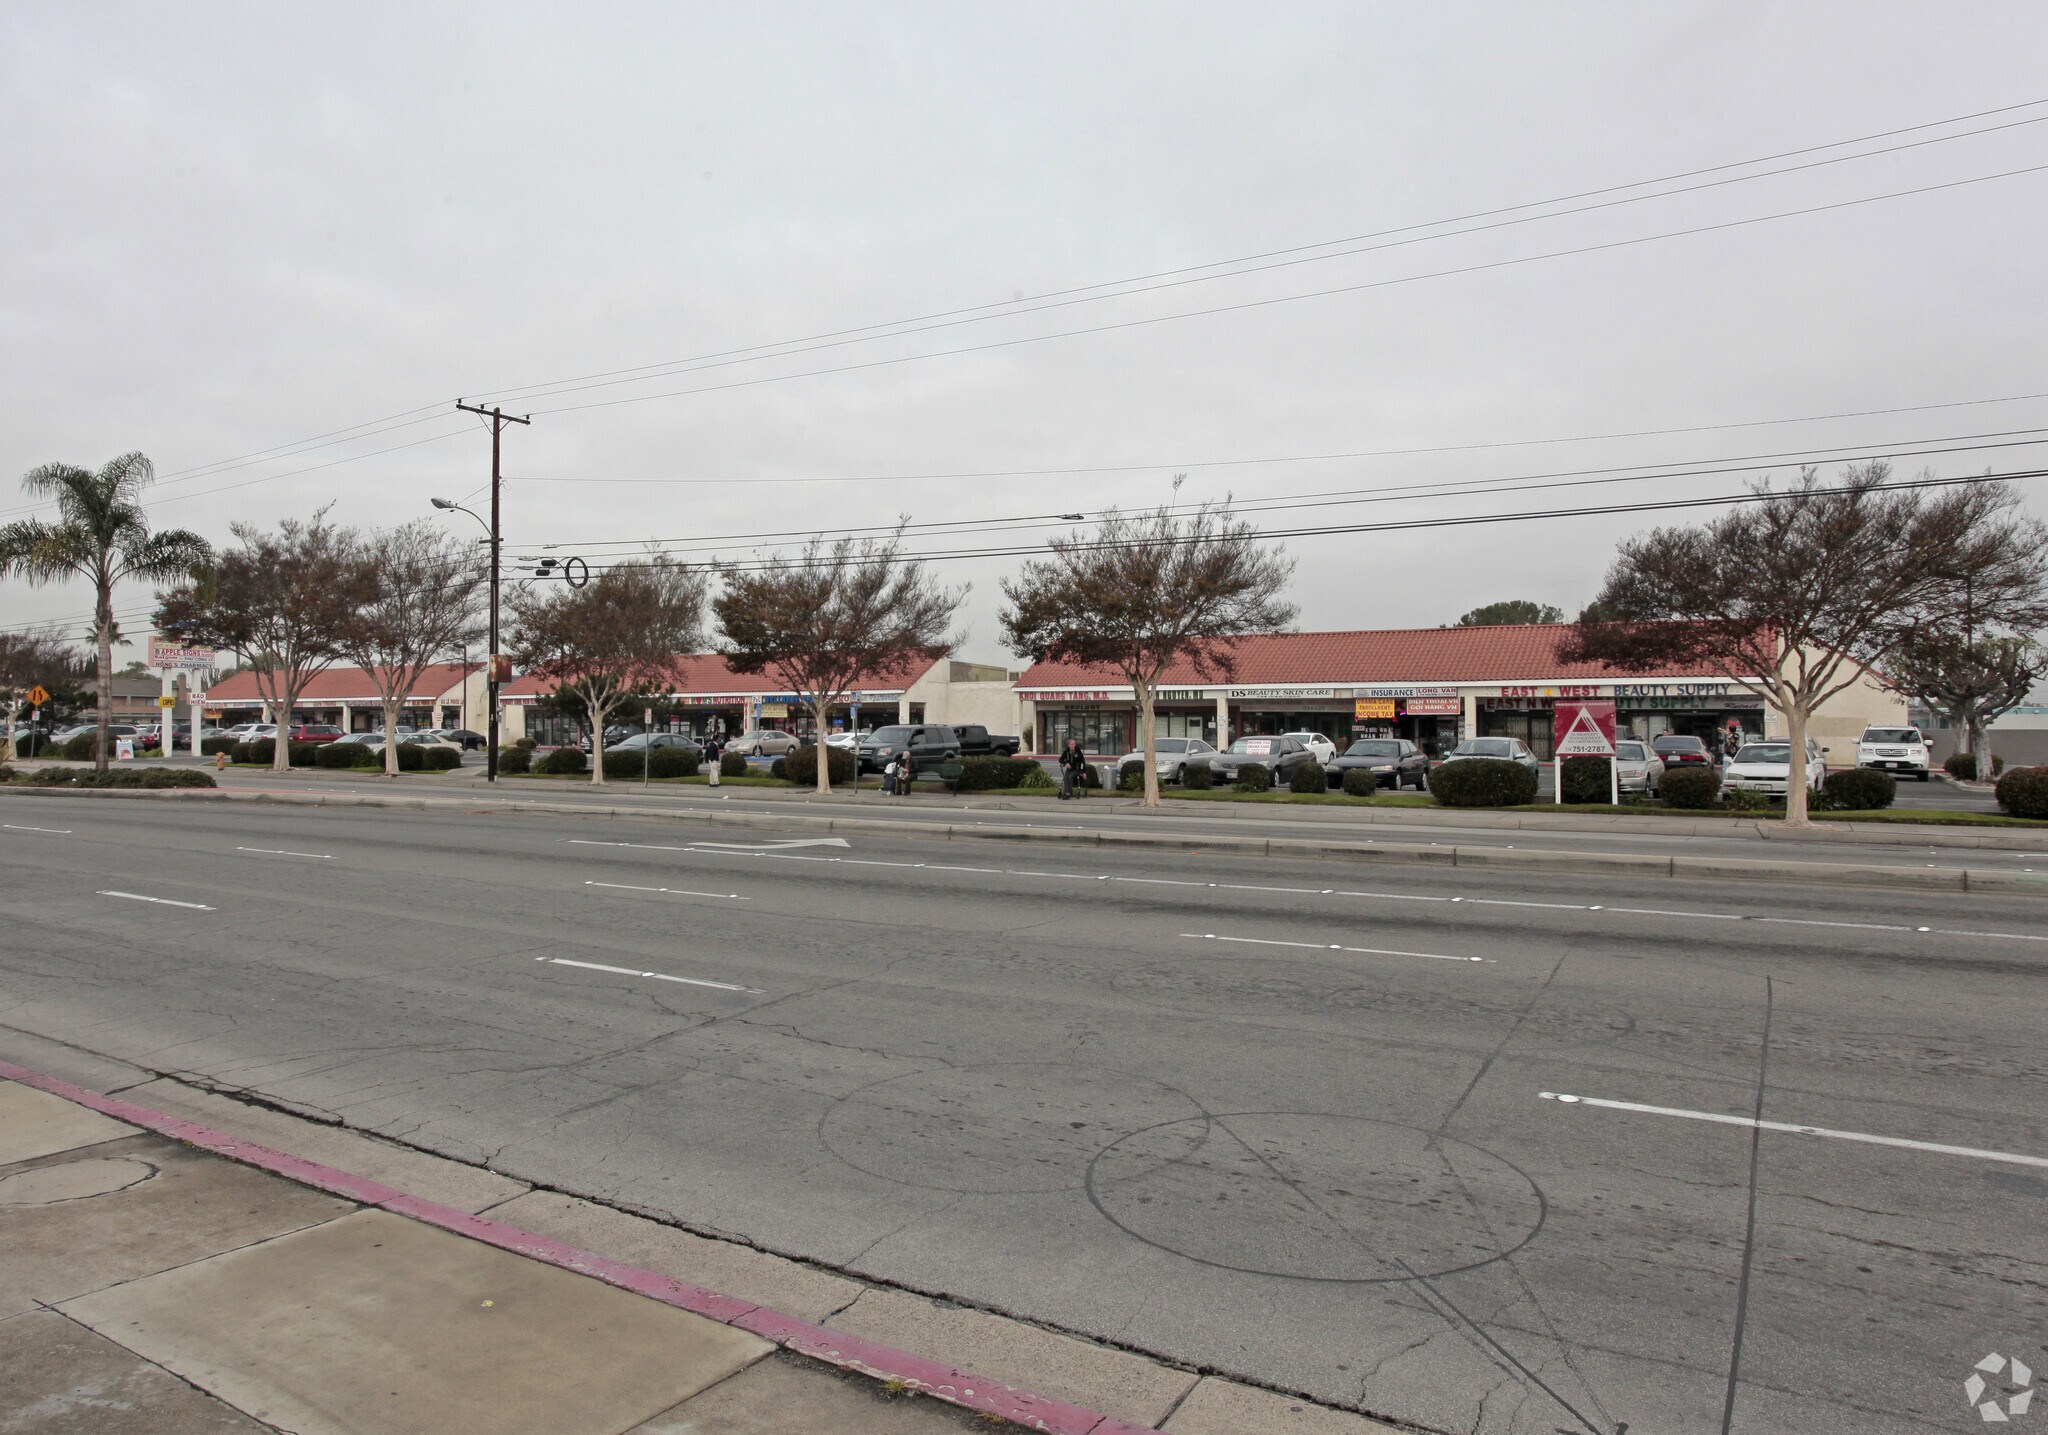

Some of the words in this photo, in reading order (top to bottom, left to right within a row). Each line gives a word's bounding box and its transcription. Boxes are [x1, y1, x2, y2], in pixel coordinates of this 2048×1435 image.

[183, 649, 201, 657] SIGNS
[1231, 690, 1247, 698] DS
[1371, 689, 1414, 697] INSURANCE
[1501, 686, 1538, 697] EAST
[1544, 688, 1553, 697] N
[1559, 686, 1601, 697] WEST
[1614, 686, 1669, 696] BEAUTY
[1677, 684, 1731, 696] SUPPLY
[1039, 692, 1066, 701] QUANG
[1650, 697, 1709, 709] SUPPLY
